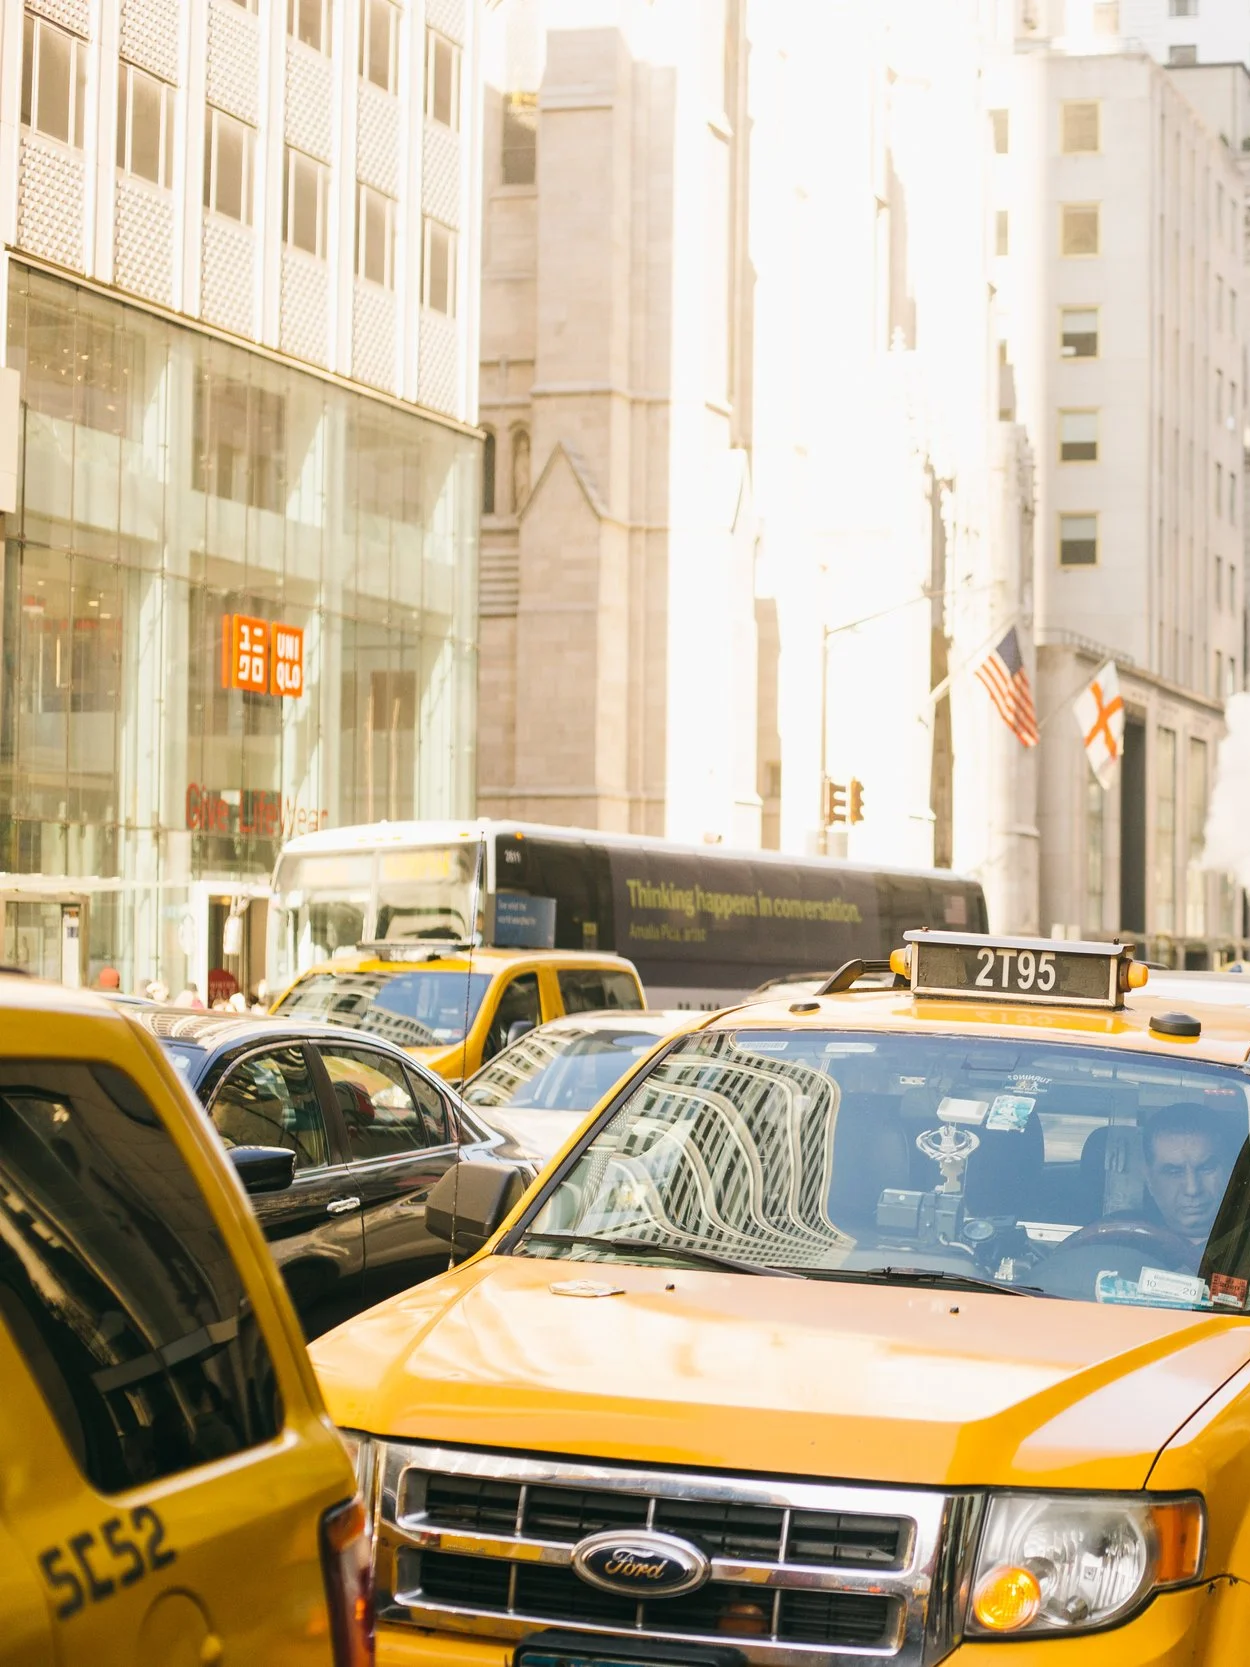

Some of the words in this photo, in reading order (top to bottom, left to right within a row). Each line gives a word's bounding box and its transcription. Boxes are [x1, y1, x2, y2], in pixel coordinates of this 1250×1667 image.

[277, 632, 300, 661] UNI
[276, 661, 301, 691] QLO
[185, 782, 229, 833] Give
[626, 879, 695, 919] Thinking
[695, 882, 756, 921] happens
[757, 889, 774, 917] in
[975, 947, 1057, 991] 2T95
[604, 1549, 670, 1580] Ford
